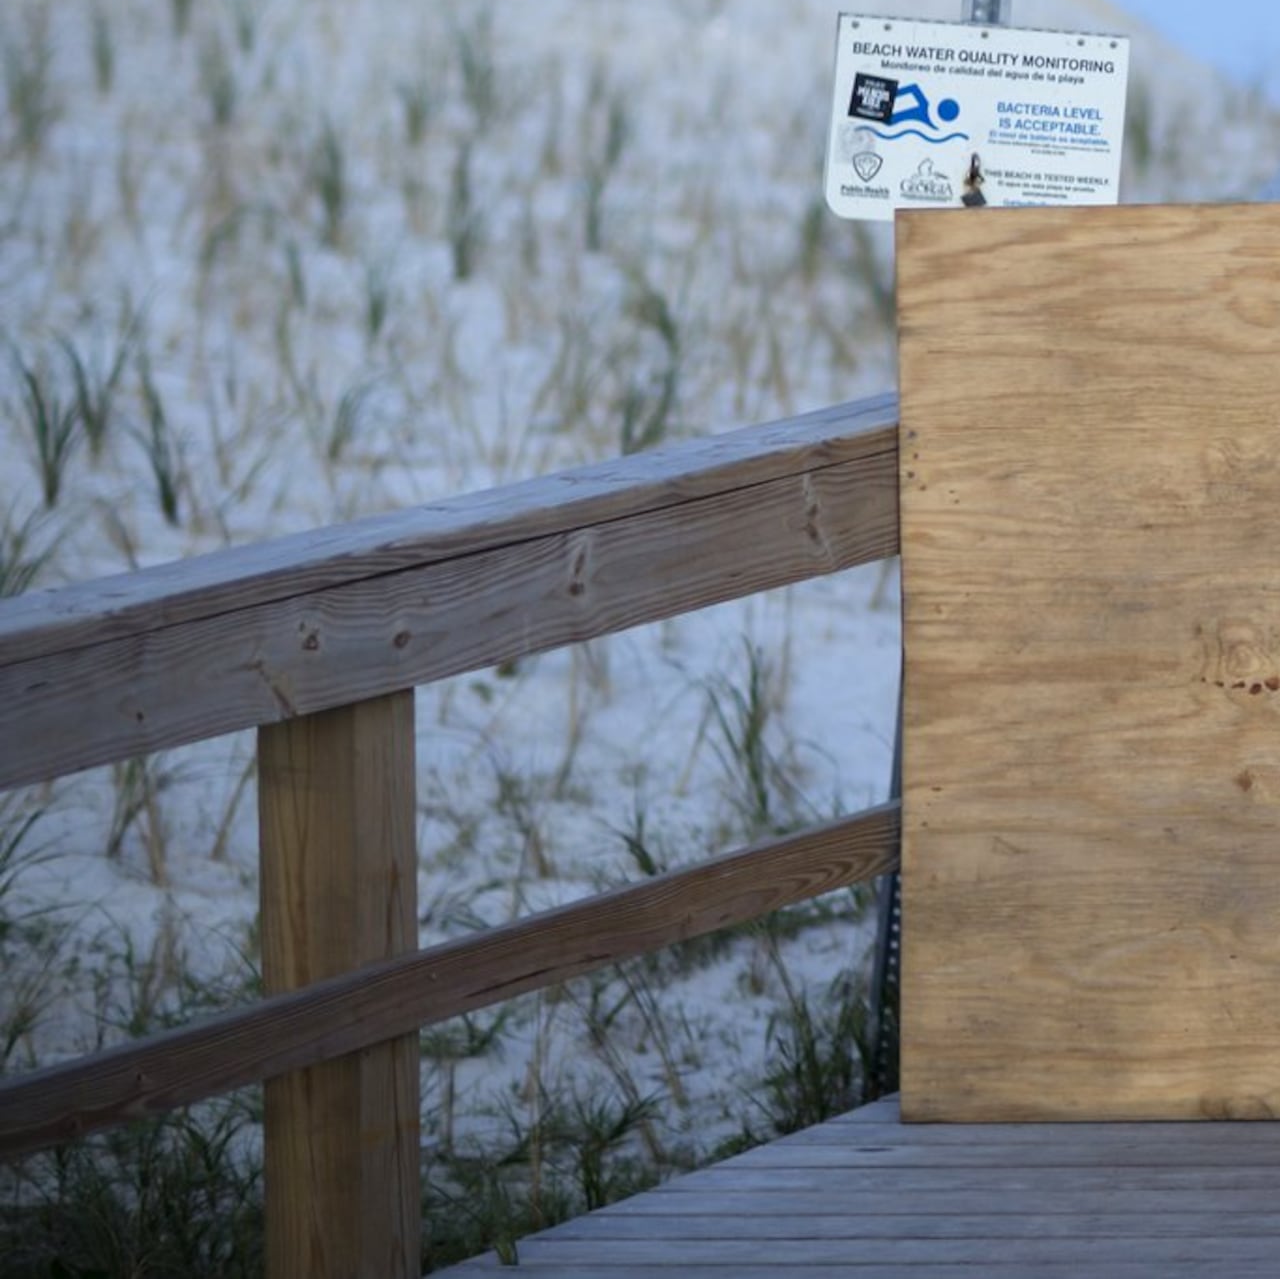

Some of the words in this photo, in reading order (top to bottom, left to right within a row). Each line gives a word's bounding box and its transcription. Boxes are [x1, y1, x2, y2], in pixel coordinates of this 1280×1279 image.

[853, 42, 902, 58] BEACH
[906, 45, 955, 61] WATER
[958, 49, 1019, 66] QUALITY
[1022, 55, 1114, 73] MONITORING
[881, 59, 931, 72] Monitoreo
[934, 63, 945, 73] de
[949, 65, 985, 76] calidad
[987, 68, 1002, 77] del
[1005, 71, 1029, 81] agua
[1032, 71, 1044, 80] de
[1047, 72, 1056, 82] la
[1058, 73, 1084, 85] playa
[997, 102, 1060, 117] BACTERIA
[1063, 106, 1103, 120] LEVEL
[999, 117, 1011, 129] IS
[1014, 119, 1100, 135] ACCEPTABLE.
[1004, 171, 1032, 180] BEACH
[1034, 172, 1043, 180] IS
[1044, 173, 1075, 183] TESTED
[841, 184, 863, 193] Public
[864, 185, 890, 195] Health
